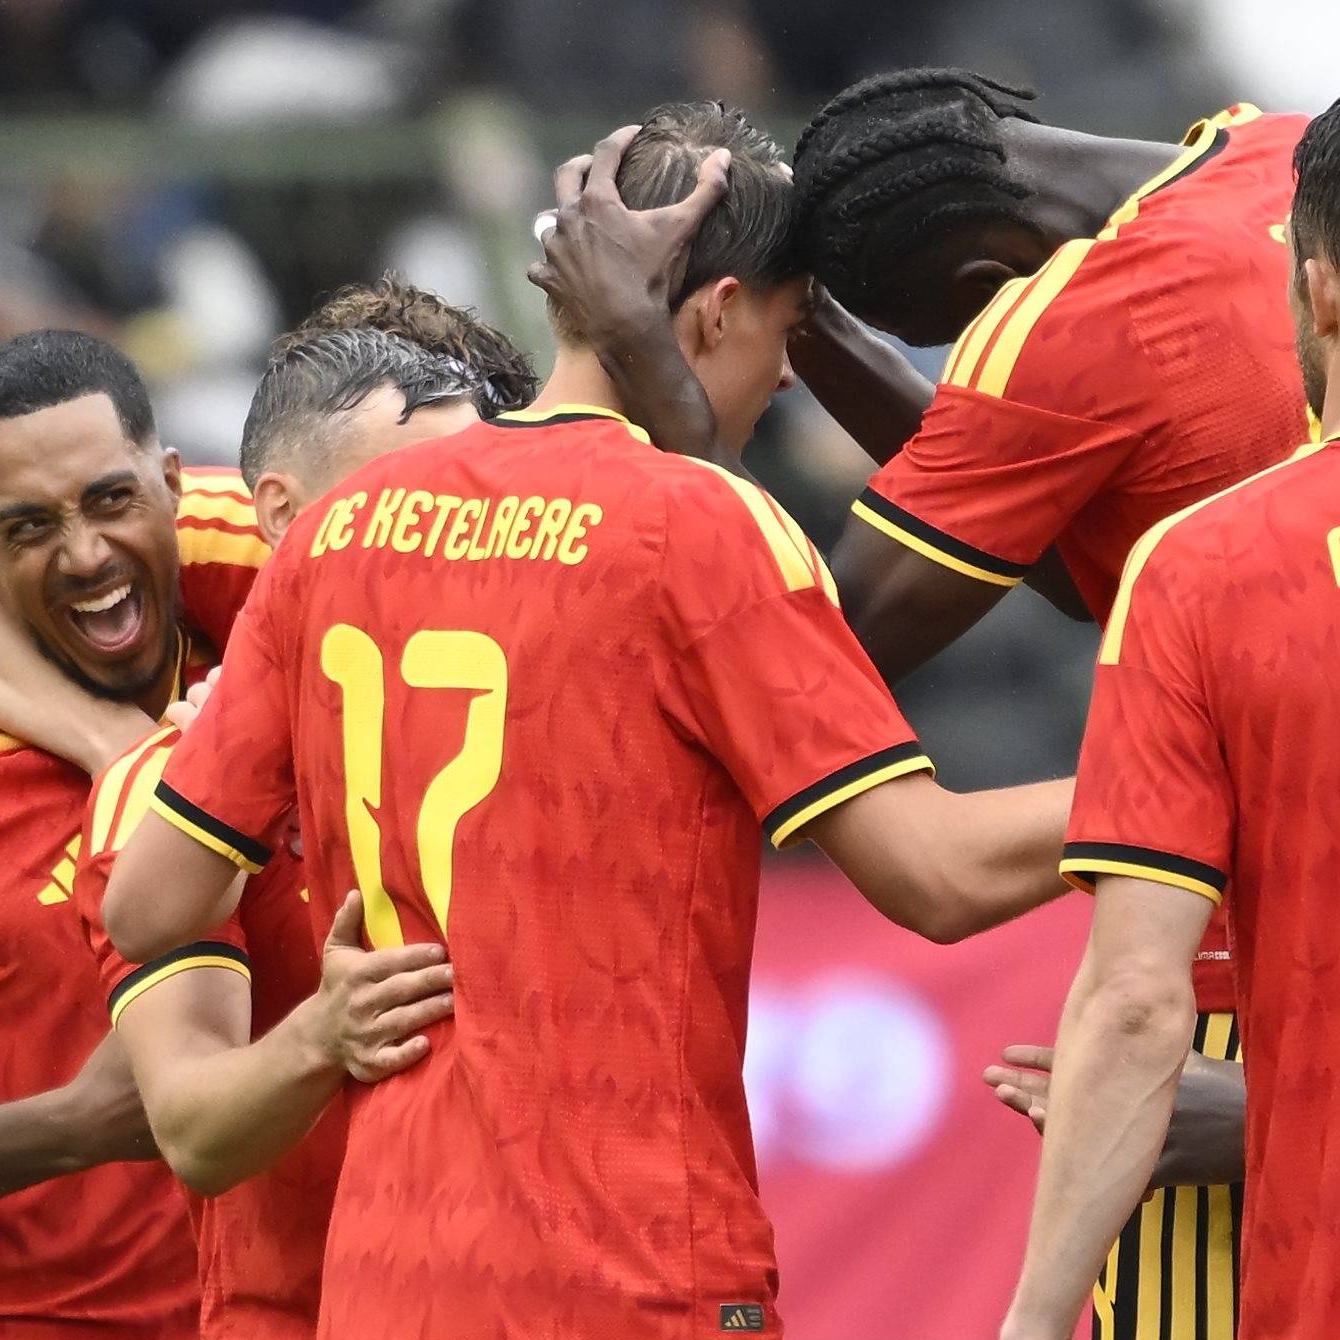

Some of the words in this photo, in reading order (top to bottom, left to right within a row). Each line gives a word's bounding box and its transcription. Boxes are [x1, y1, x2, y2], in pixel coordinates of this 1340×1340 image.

[310, 491, 368, 558] DE
[363, 488, 603, 565] KETELAERE
[321, 623, 508, 951] 17
